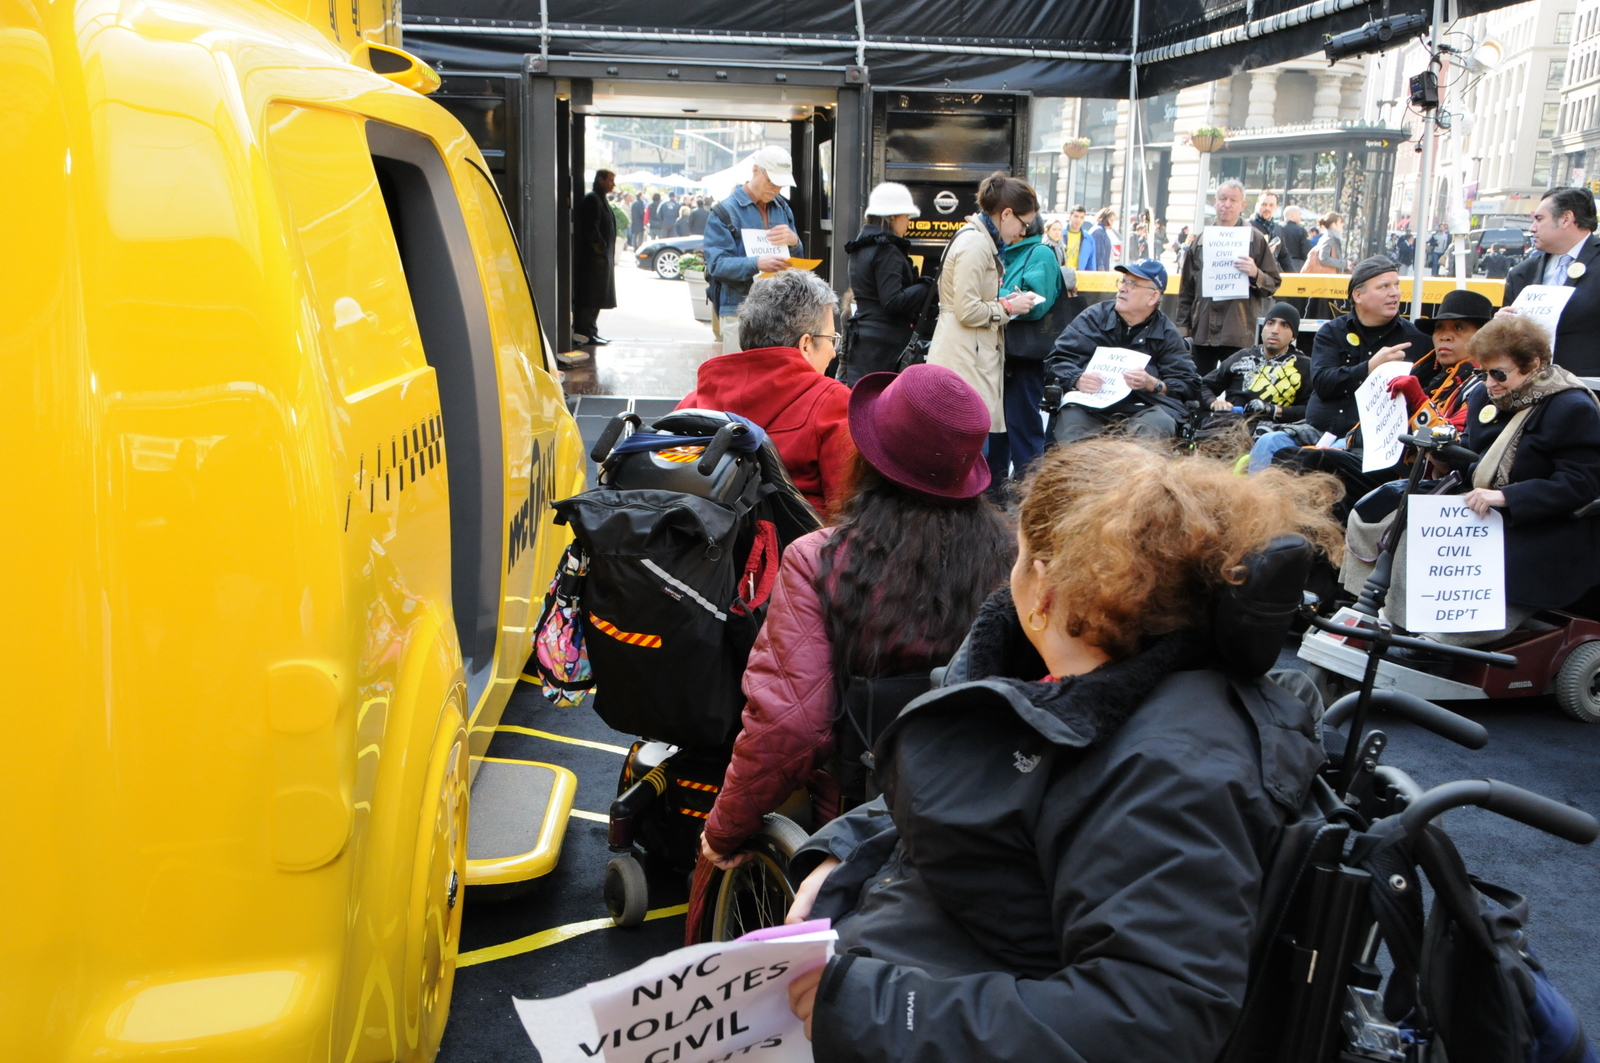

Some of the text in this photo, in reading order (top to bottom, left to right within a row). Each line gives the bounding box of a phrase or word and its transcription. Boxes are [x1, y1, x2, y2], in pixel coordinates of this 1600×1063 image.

[1365, 140, 1382, 148] Sprint
[931, 222, 967, 230] TOMO
[751, 246, 782, 254] VIOLATES
[1215, 283, 1236, 291] DEP'T
[1524, 293, 1547, 301] NYC
[1107, 353, 1128, 363] NYC
[1376, 401, 1397, 435] RIGHTS
[1440, 507, 1469, 518] NYC
[1421, 526, 1489, 538] VIOLATES
[1437, 546, 1472, 557] CIVIL
[1429, 565, 1482, 576] RIGHTS
[1436, 608, 1478, 621] DEP'T
[1508, 681, 1533, 689] AMIGA
[632, 952, 722, 1007] NYC
[578, 960, 790, 1058] VIOLATES
[643, 1010, 750, 1063] CIVIL
